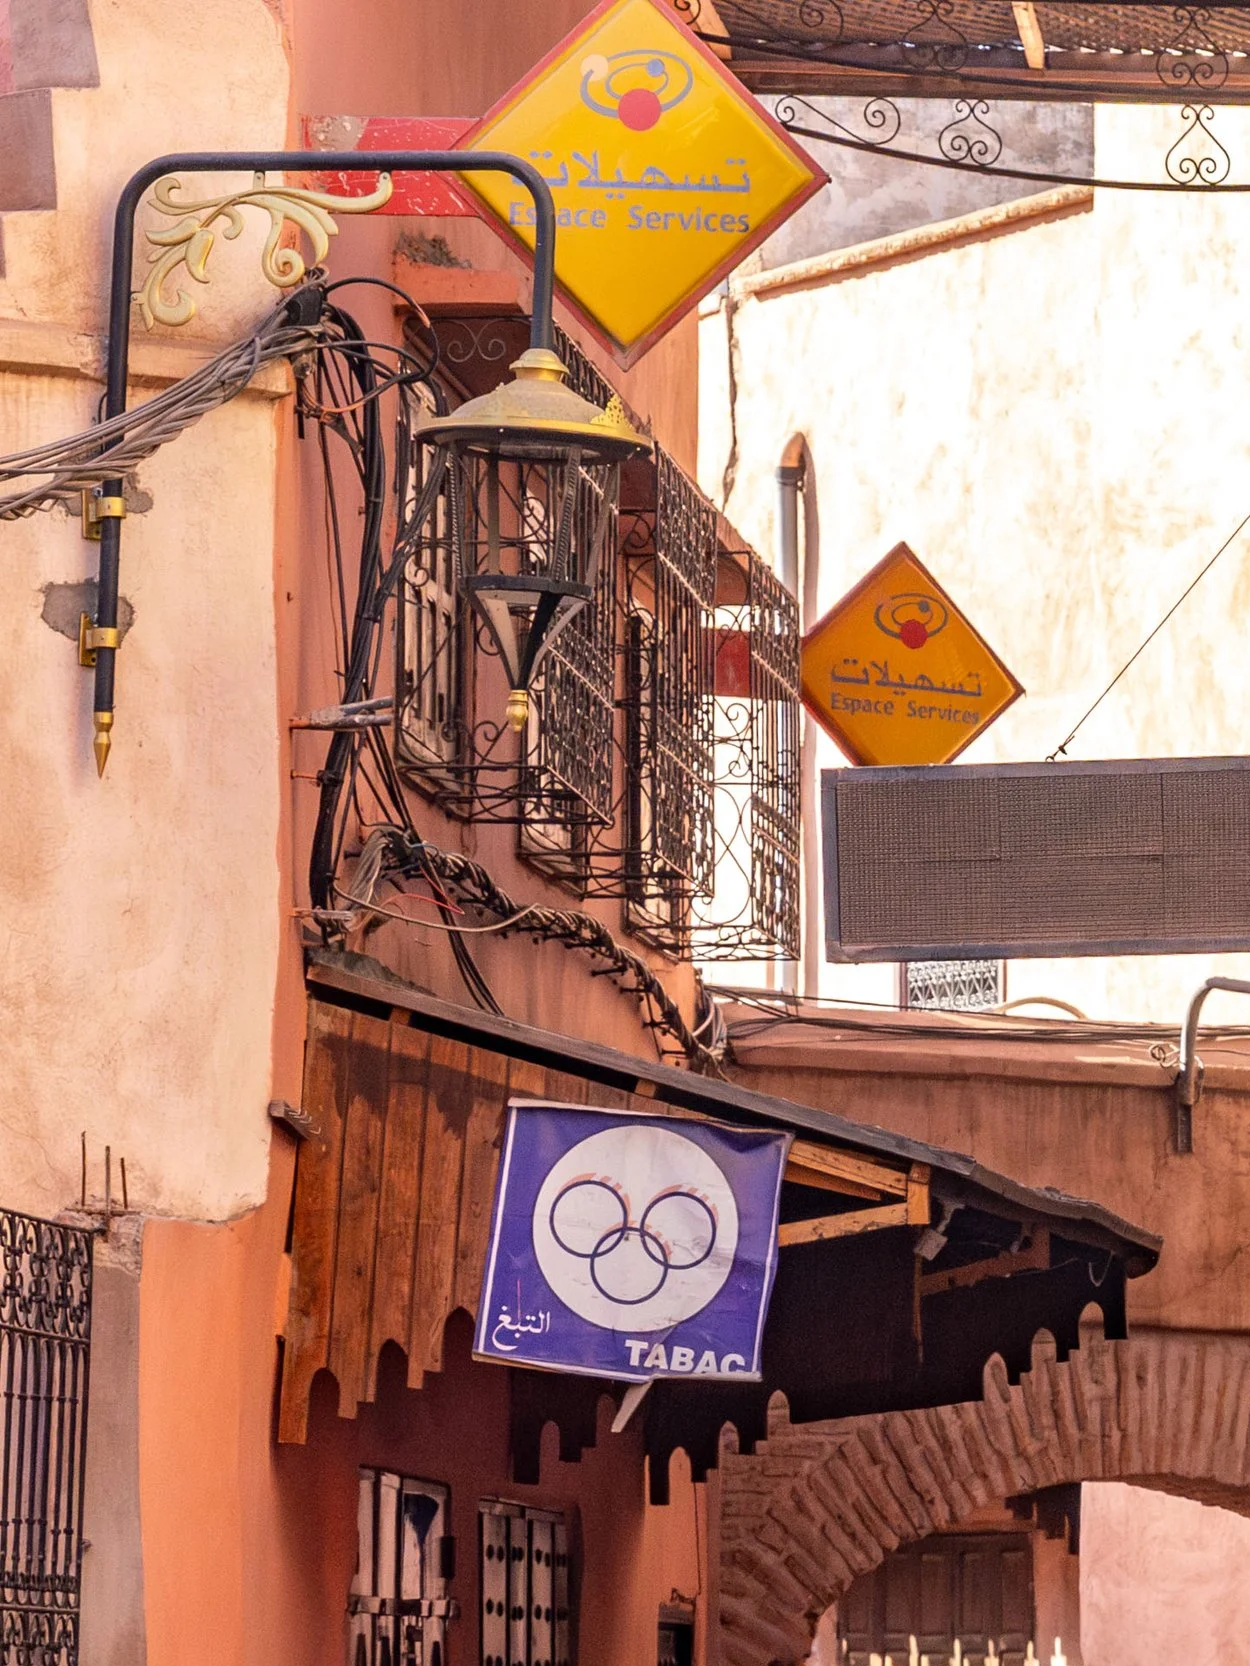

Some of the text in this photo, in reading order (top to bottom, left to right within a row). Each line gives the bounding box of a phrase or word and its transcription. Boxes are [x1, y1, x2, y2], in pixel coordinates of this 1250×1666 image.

[508, 201, 750, 233] Esace Services
[831, 658, 982, 697] تسهيلات
[831, 692, 980, 725] Espace Services
[491, 1305, 551, 1351] التبغ
[624, 1339, 746, 1374] TABAC
